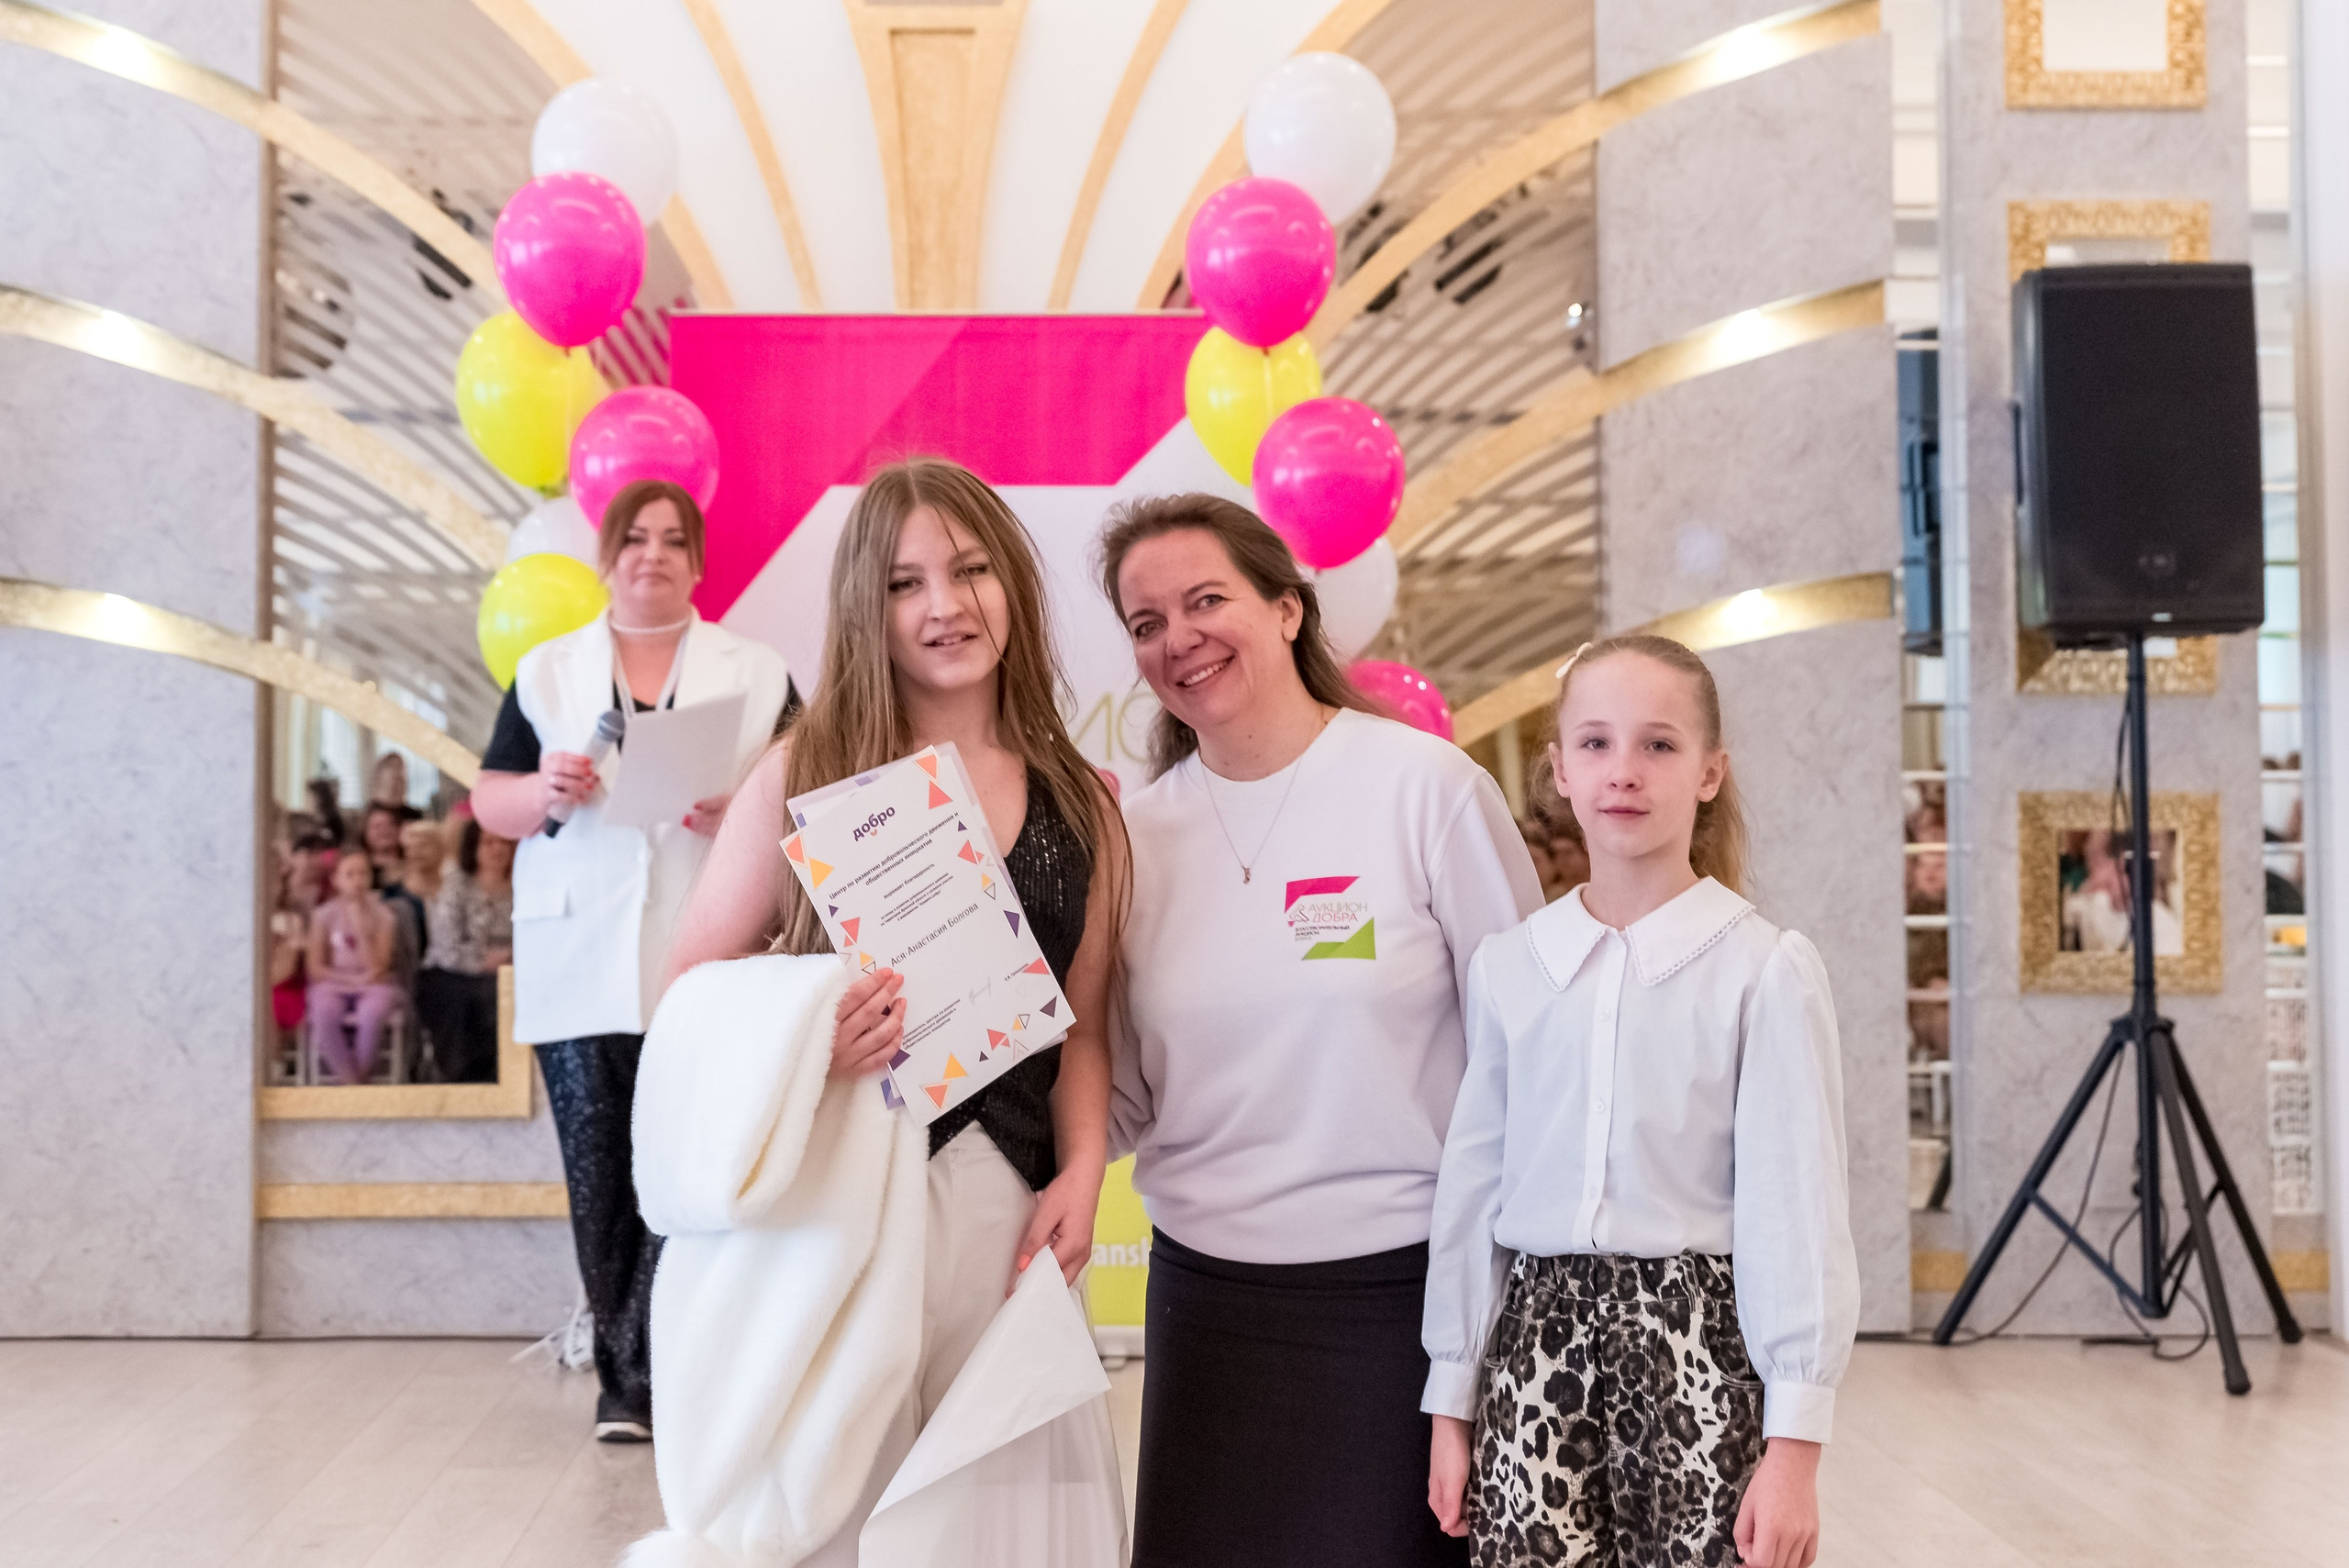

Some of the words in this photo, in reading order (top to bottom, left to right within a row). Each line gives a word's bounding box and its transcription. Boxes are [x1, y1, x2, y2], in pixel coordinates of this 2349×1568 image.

[852, 806, 896, 842] добро
[829, 885, 848, 900] Центр
[846, 881, 855, 889] по
[854, 863, 881, 884] развитию
[880, 832, 929, 867] добровольческого
[928, 815, 955, 835] движения
[865, 858, 905, 886] общественных
[904, 839, 933, 860] инициатив
[904, 863, 935, 885] благодарность
[1309, 903, 1367, 914] АУКЦИОН
[1313, 912, 1358, 922] ДОБРА
[891, 924, 948, 967] Ася-Анастасия
[947, 903, 979, 928] Болгова
